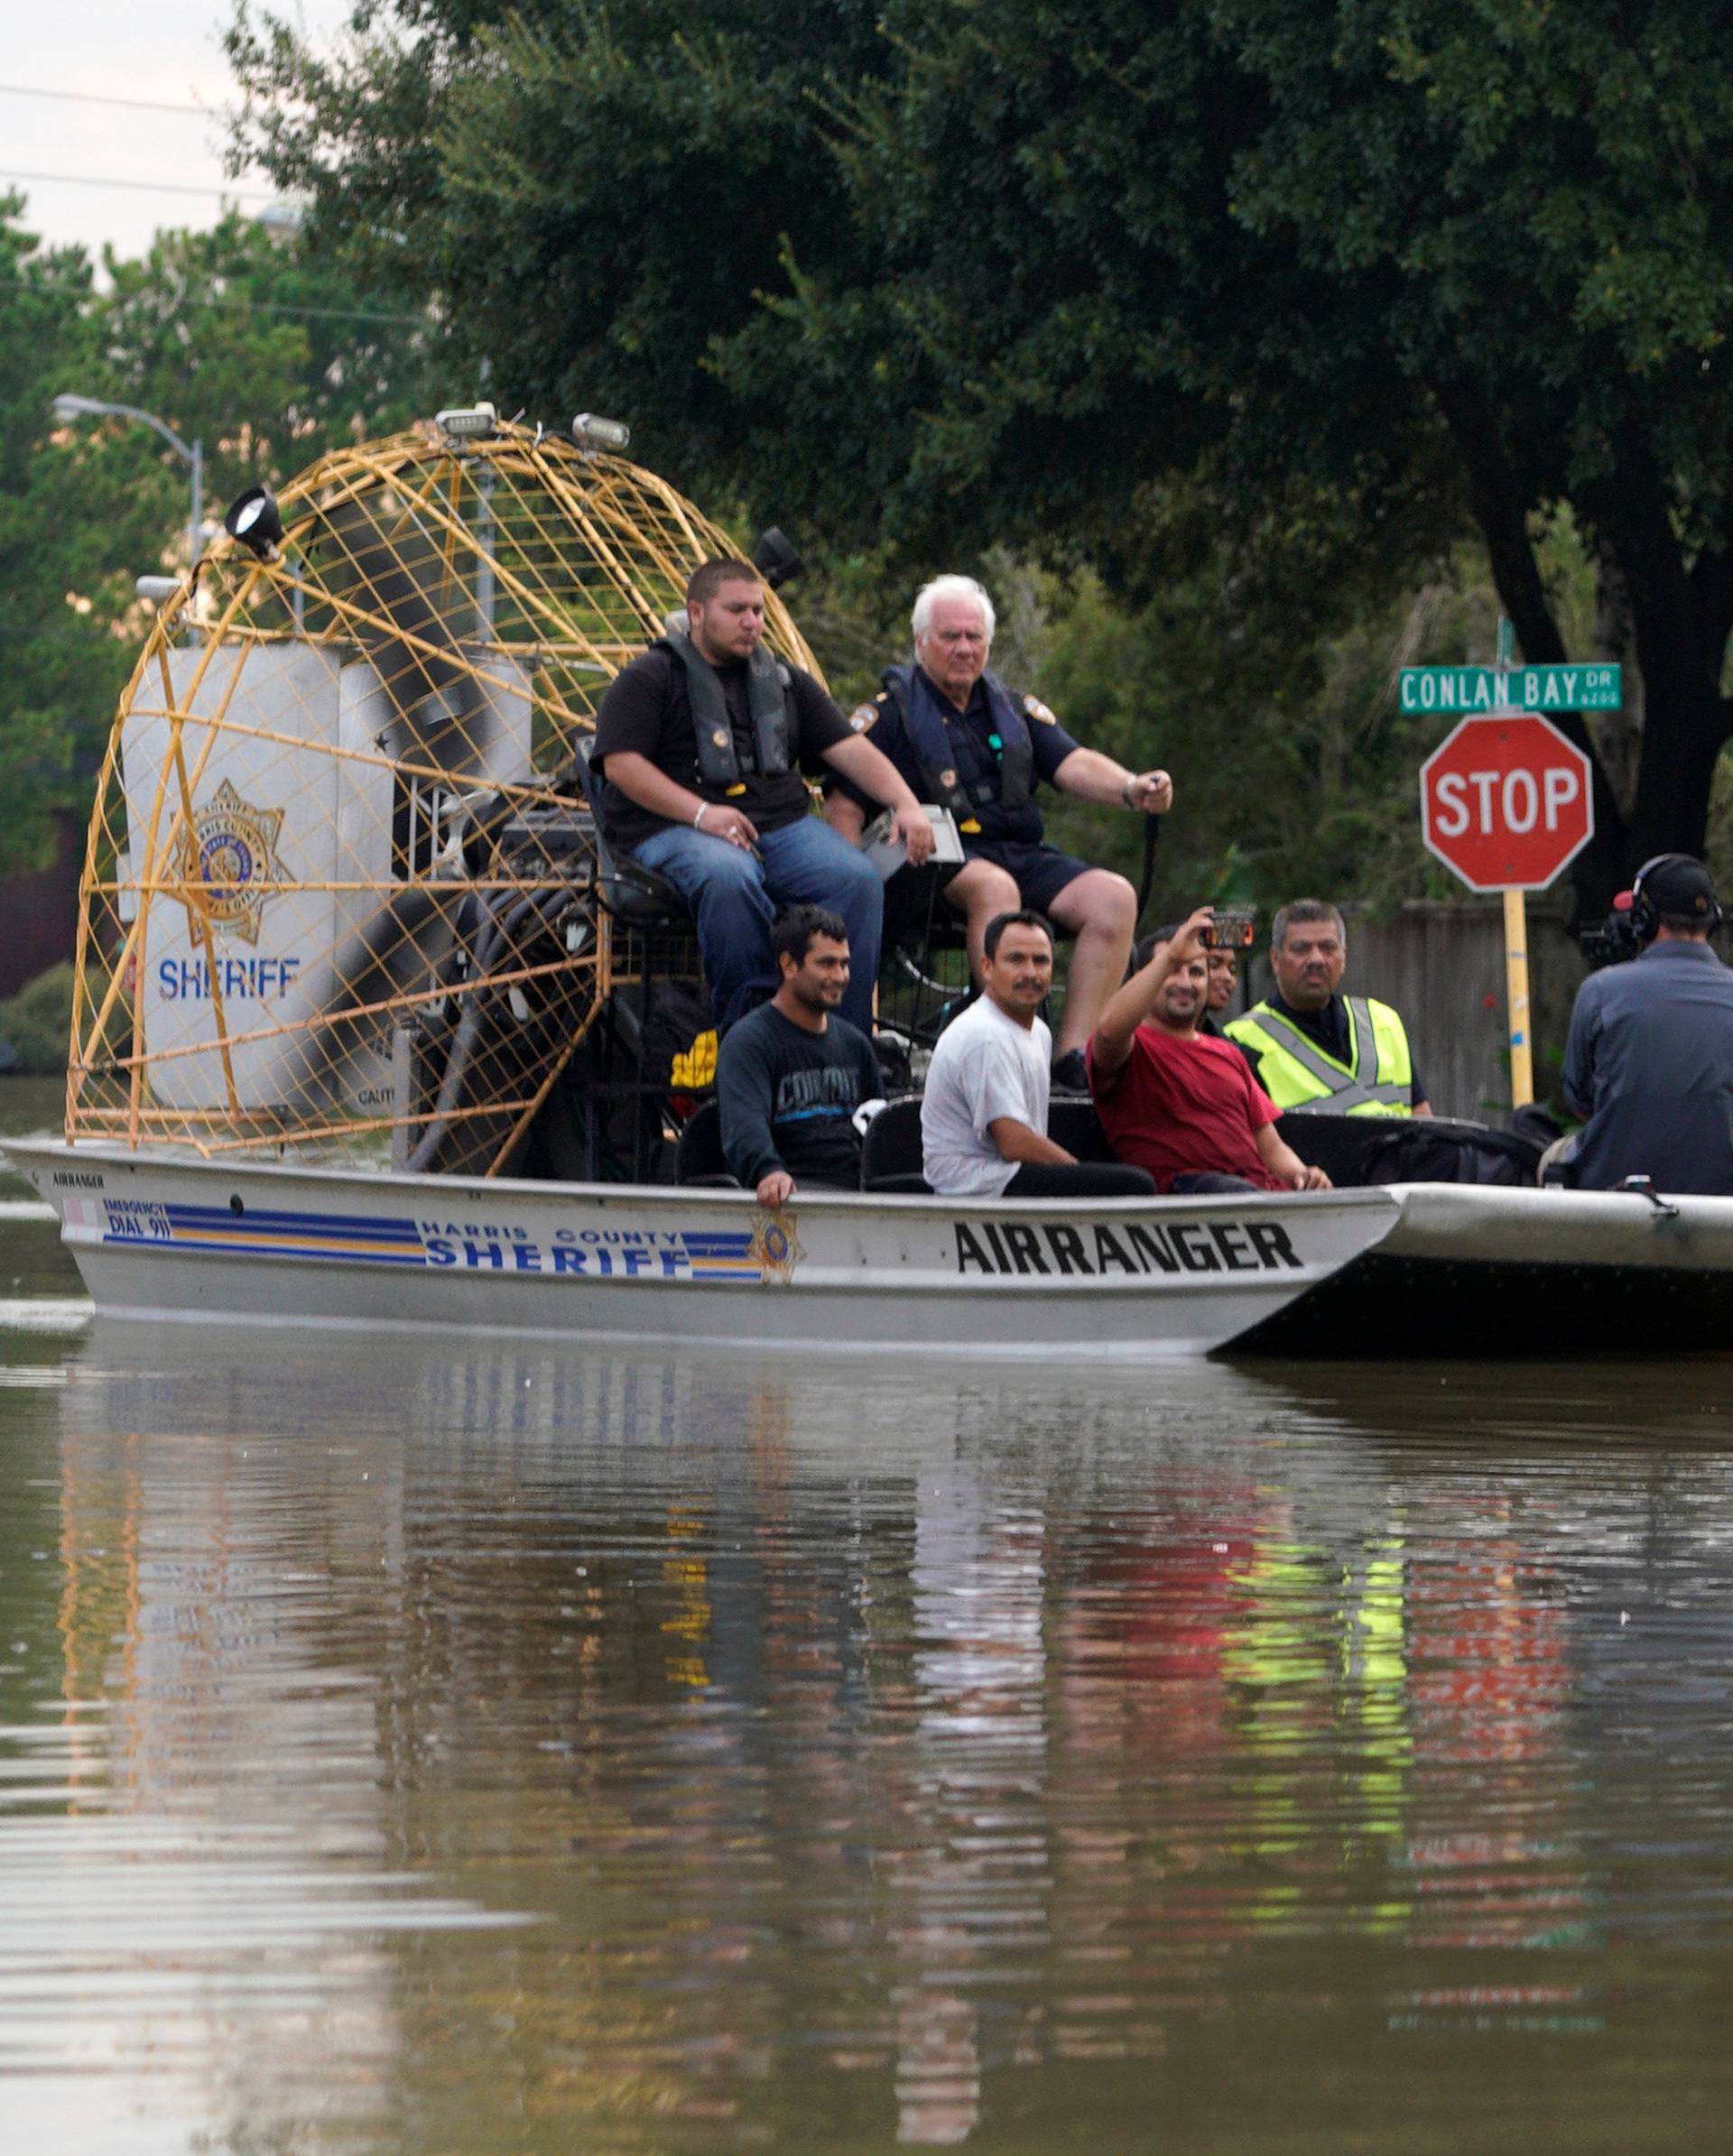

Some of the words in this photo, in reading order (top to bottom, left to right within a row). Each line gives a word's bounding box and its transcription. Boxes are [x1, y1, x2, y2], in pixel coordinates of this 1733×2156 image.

[1401, 671, 1509, 708] CONLAN
[1524, 671, 1578, 706] BAY
[1586, 670, 1612, 688] DR
[1435, 767, 1580, 837] STOP
[158, 958, 301, 1002] SHERIFF
[103, 1198, 165, 1215] EMERGENCY
[108, 1215, 144, 1236] DIAL
[149, 1217, 171, 1239] 911
[421, 1220, 528, 1241] HARRIS
[555, 1227, 680, 1246] COUNTY
[426, 1239, 691, 1277] SHERIFF
[954, 1221, 1305, 1275] AIRRANGER
